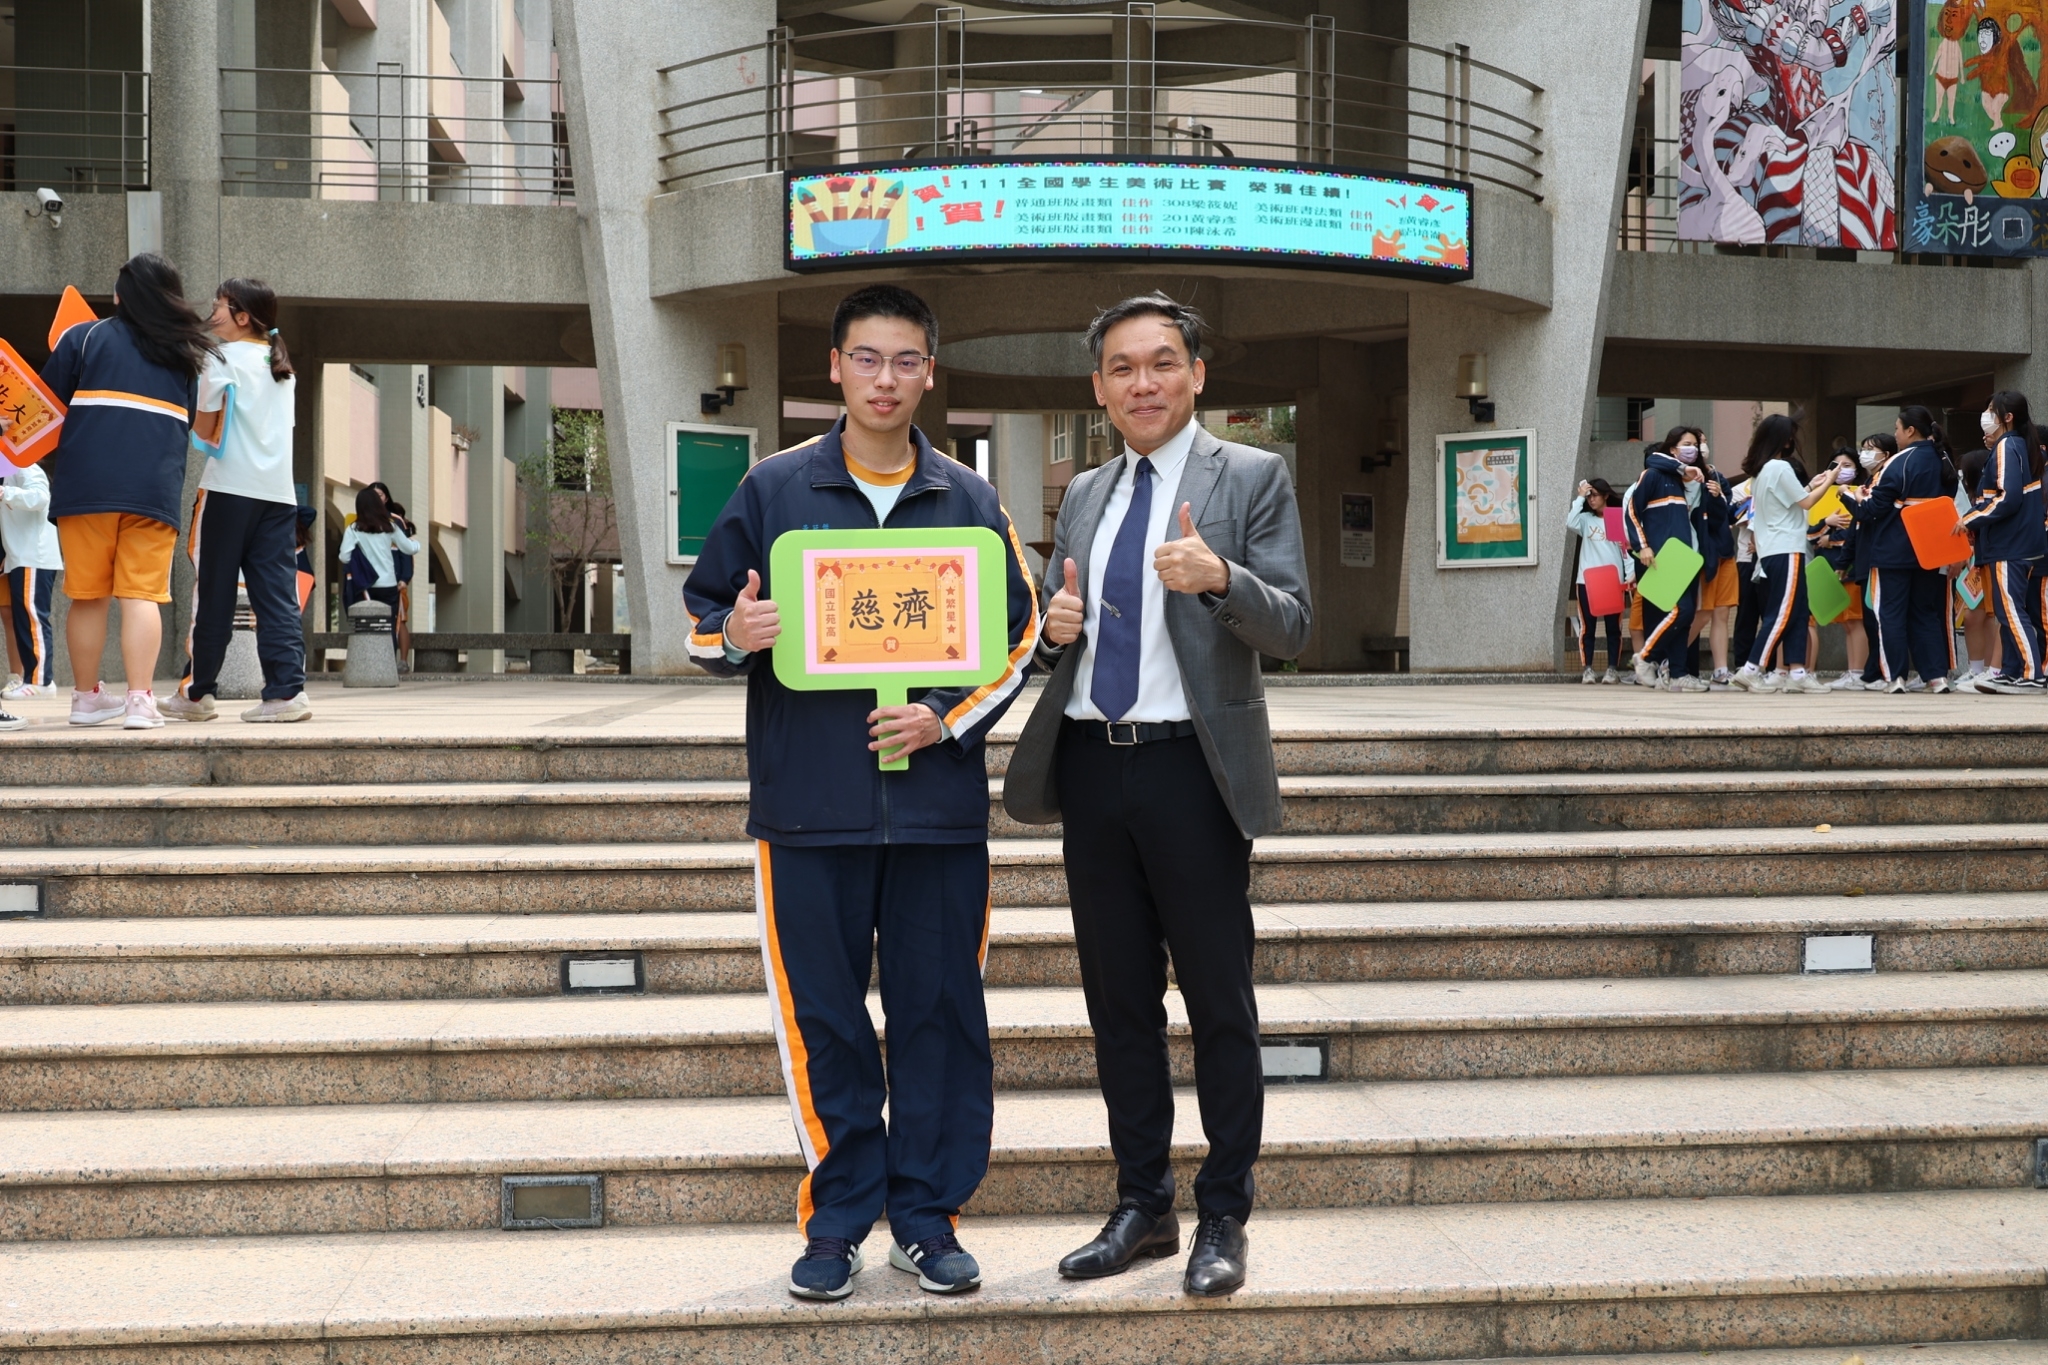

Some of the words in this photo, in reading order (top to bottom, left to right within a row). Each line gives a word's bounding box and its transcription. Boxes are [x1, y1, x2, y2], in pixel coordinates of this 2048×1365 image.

[1122, 198, 1153, 208] 佳作
[1122, 212, 1153, 222] 佳作
[1122, 224, 1153, 235] 佳作
[824, 588, 837, 638] 國立苑高
[848, 587, 936, 631] 慈濟
[885, 639, 897, 651] 賀
